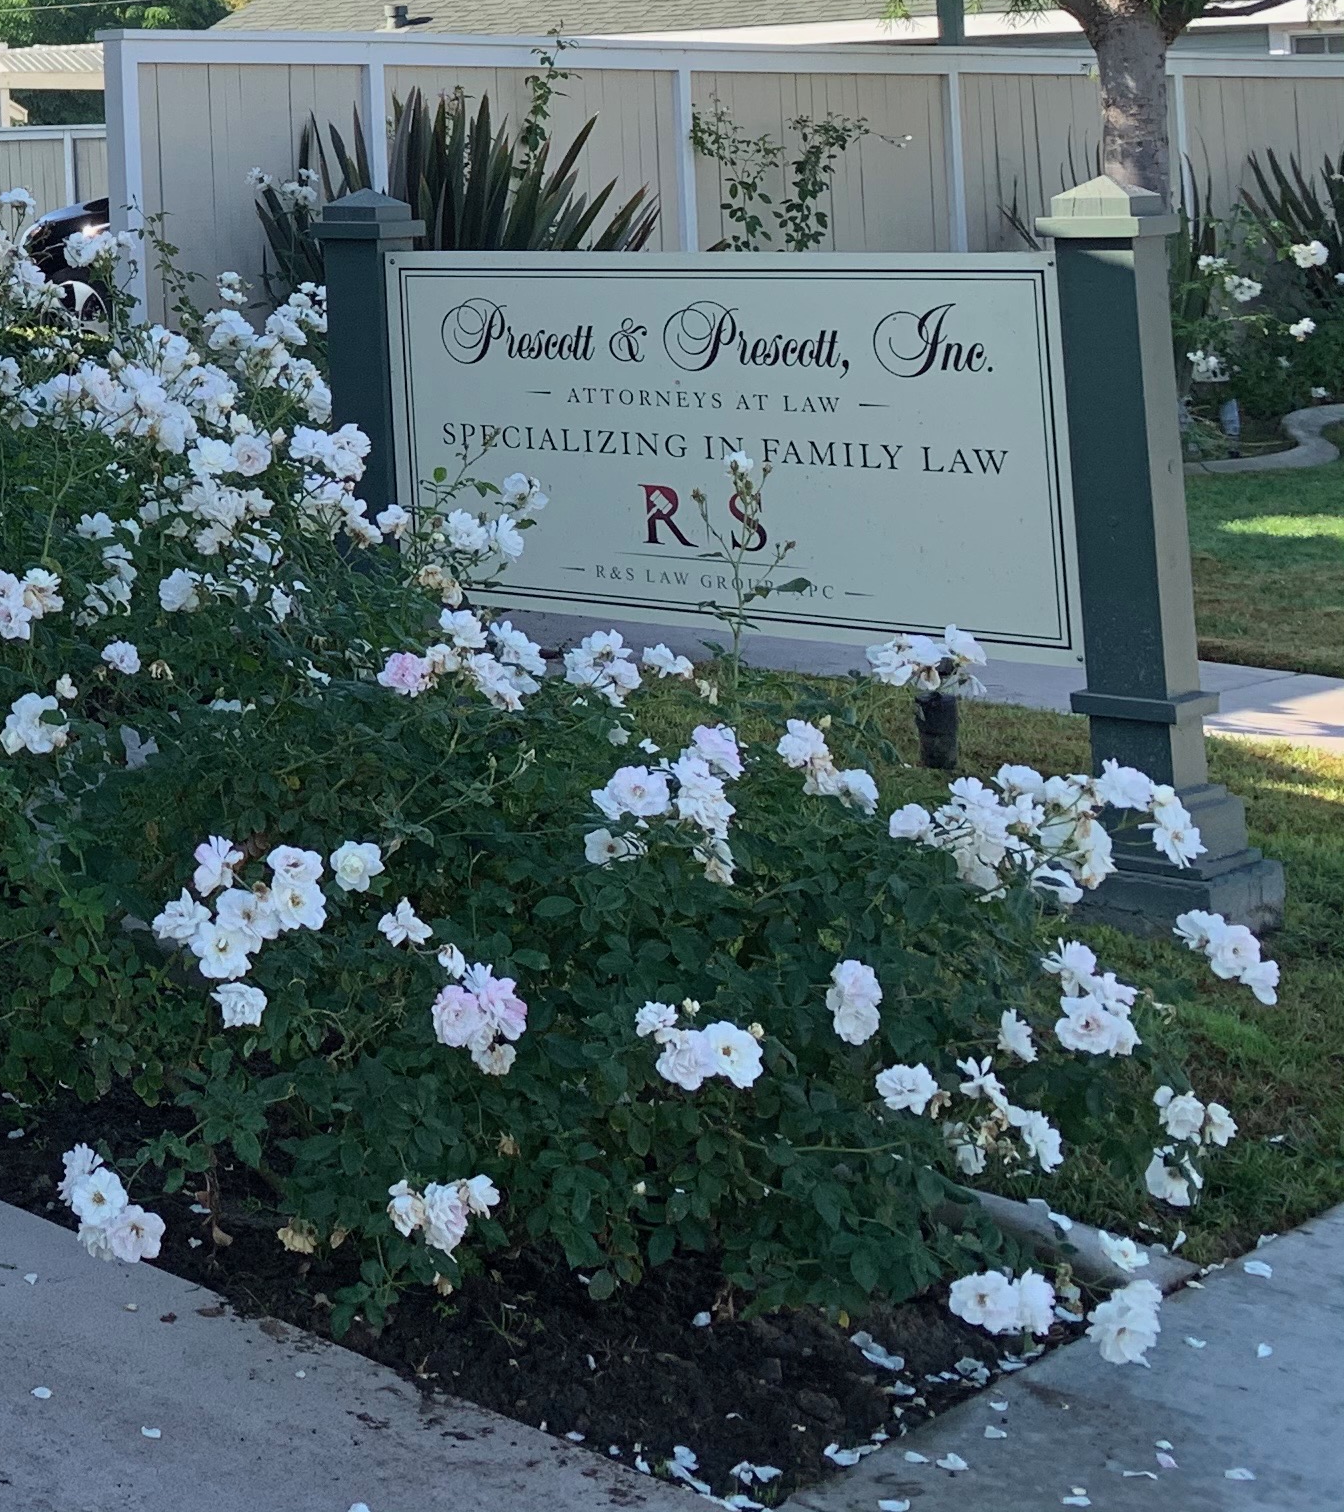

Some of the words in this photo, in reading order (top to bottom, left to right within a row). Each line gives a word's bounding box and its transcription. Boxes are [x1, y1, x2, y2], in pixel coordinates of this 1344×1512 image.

[441, 297, 596, 365] Prescott
[608, 317, 648, 363] &
[662, 300, 850, 379] Prescott,
[873, 303, 994, 378] Inc.
[566, 387, 722, 409] ATTORNEYS
[736, 393, 769, 412] AT
[783, 394, 840, 414] LAW
[442, 422, 688, 458] SPECIALIZING
[703, 435, 744, 460] IN
[760, 438, 903, 471] FAMILY
[920, 445, 1009, 476] LAW
[637, 483, 699, 548] R
[595, 564, 635, 582] R&S
[646, 569, 690, 586] LAW
